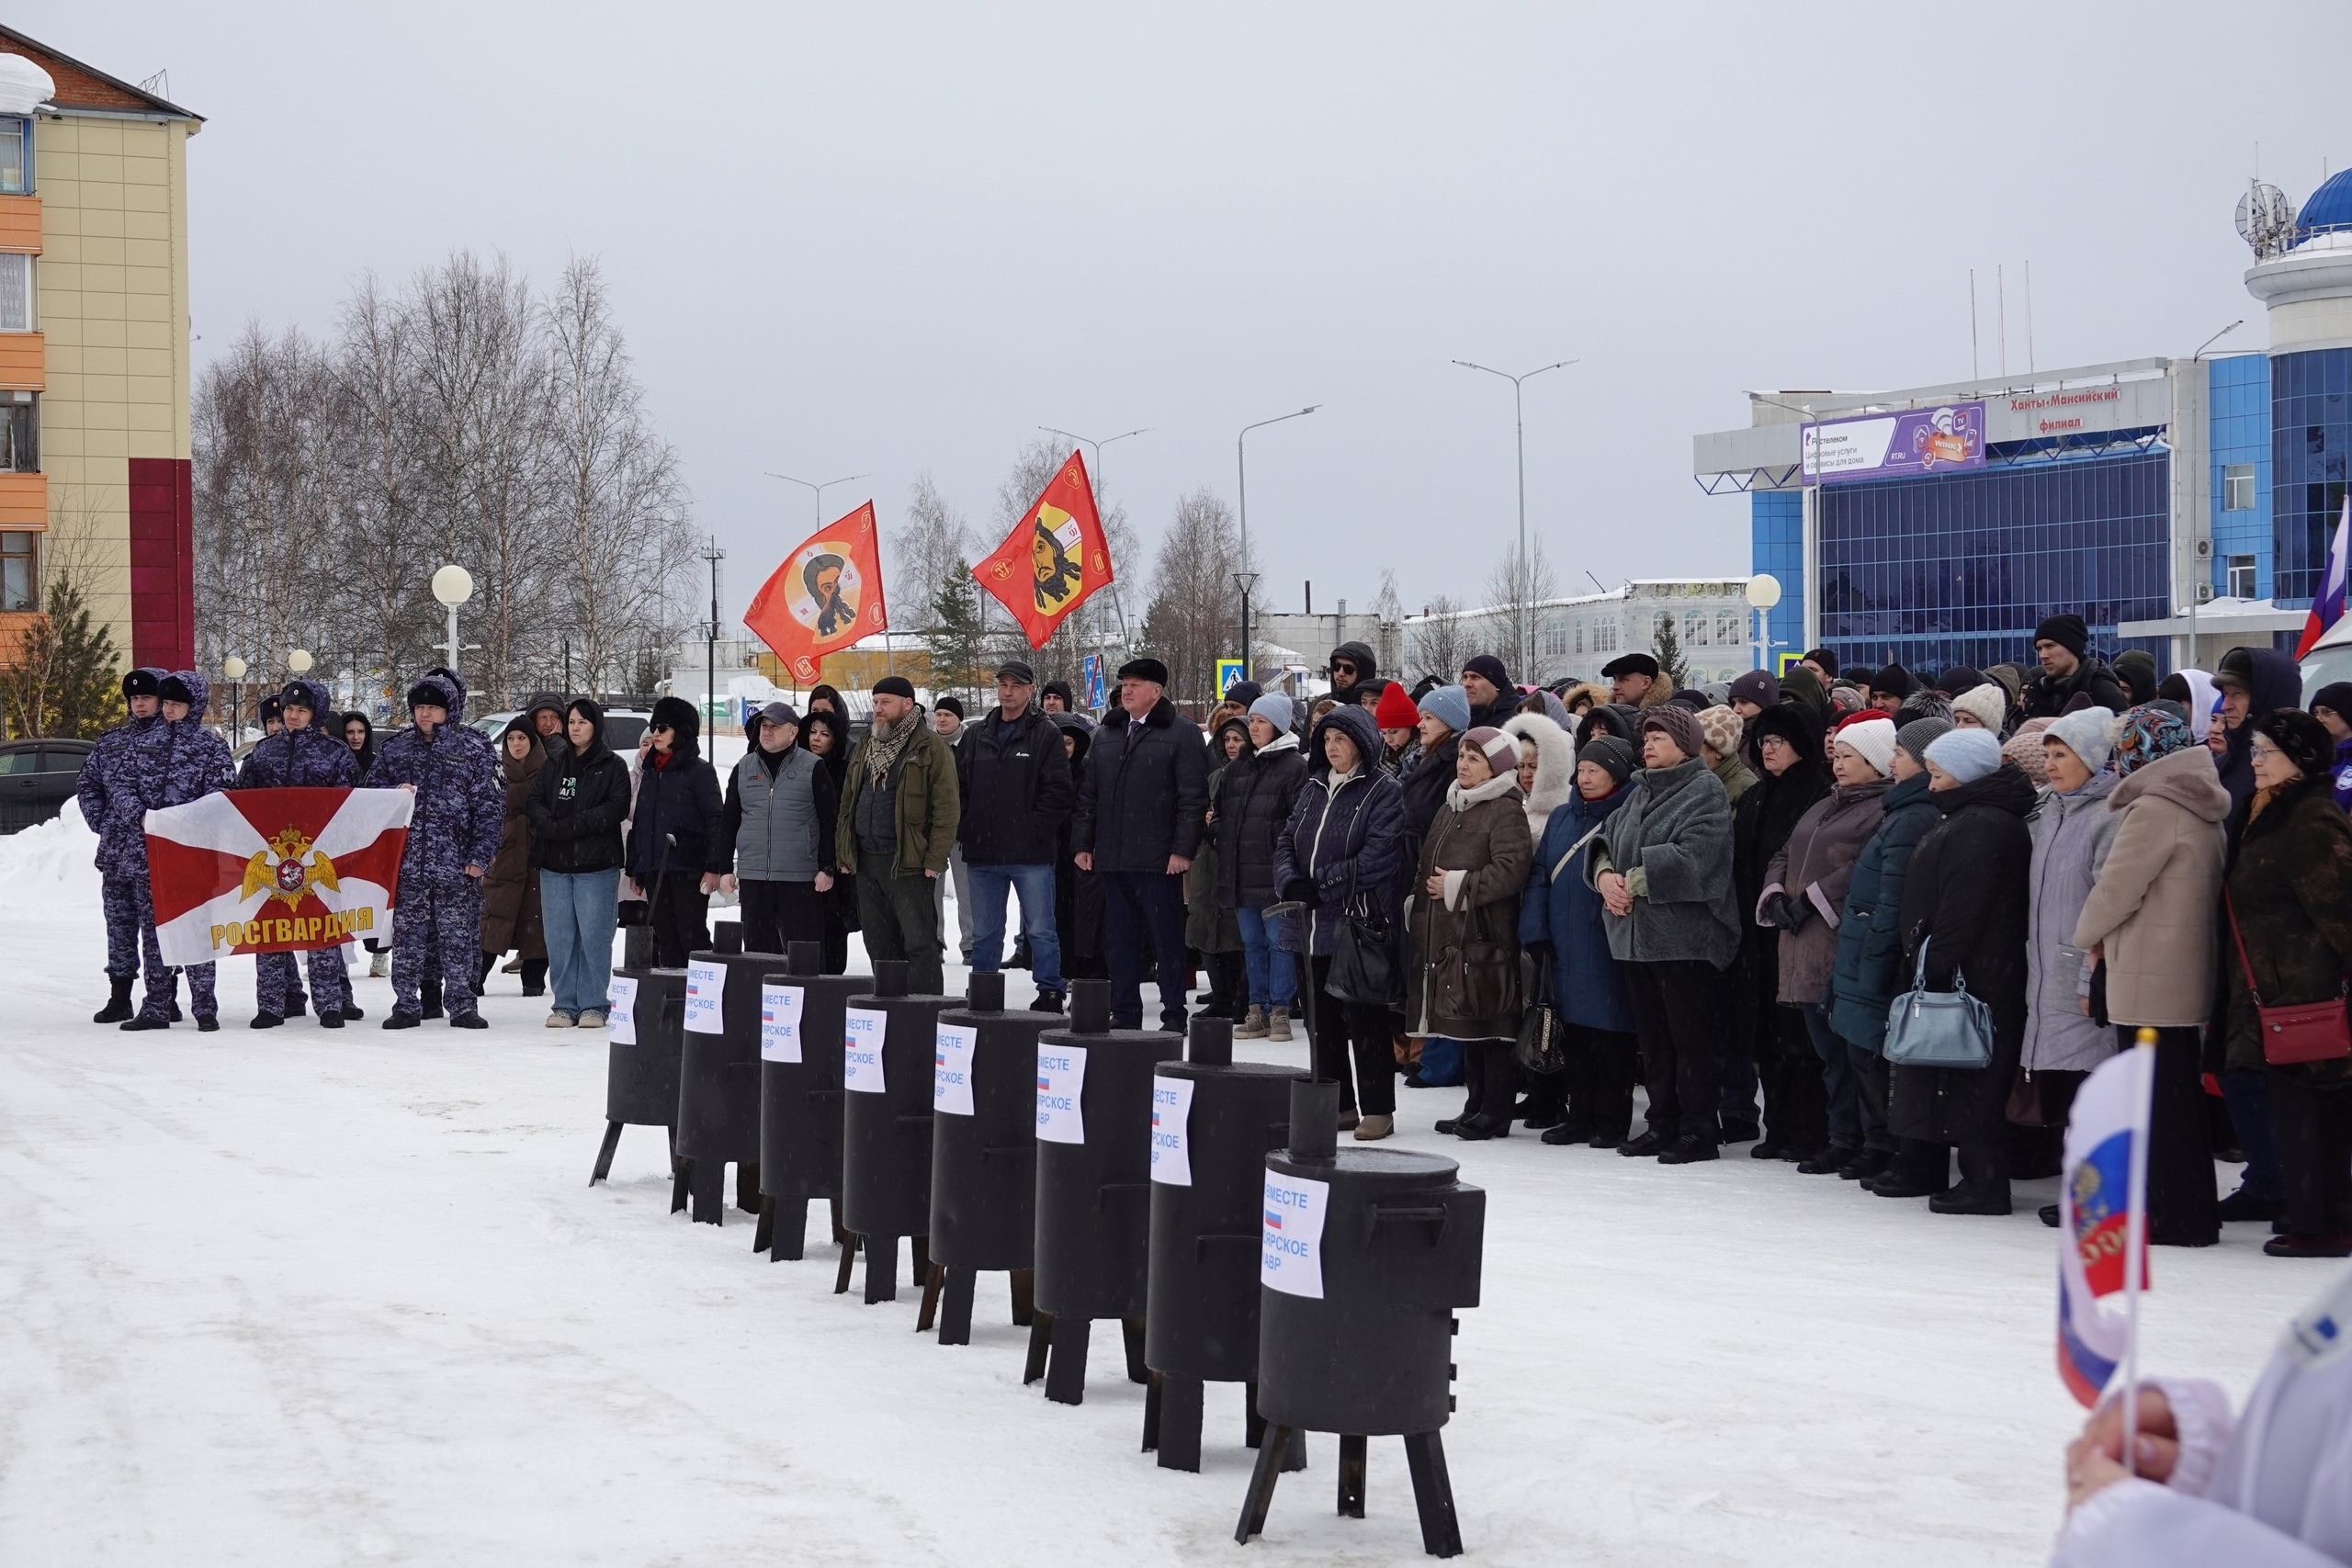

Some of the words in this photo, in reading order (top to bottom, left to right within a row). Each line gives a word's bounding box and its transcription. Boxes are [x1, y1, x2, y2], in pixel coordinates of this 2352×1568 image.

[2010, 387, 2119, 412] Ханты-Мансийский
[2040, 418, 2081, 434] филиал
[1811, 435, 1848, 446] Рстелеком
[1805, 449, 1836, 460] Цифовые
[1837, 447, 1857, 457] услуги
[1811, 460, 1835, 468] севисы
[1836, 458, 1847, 467] для
[1848, 457, 1864, 465] дома
[210, 906, 374, 951] РОСГВАРДИЯ
[1266, 1183, 1308, 1209] ВМЕСТЕ
